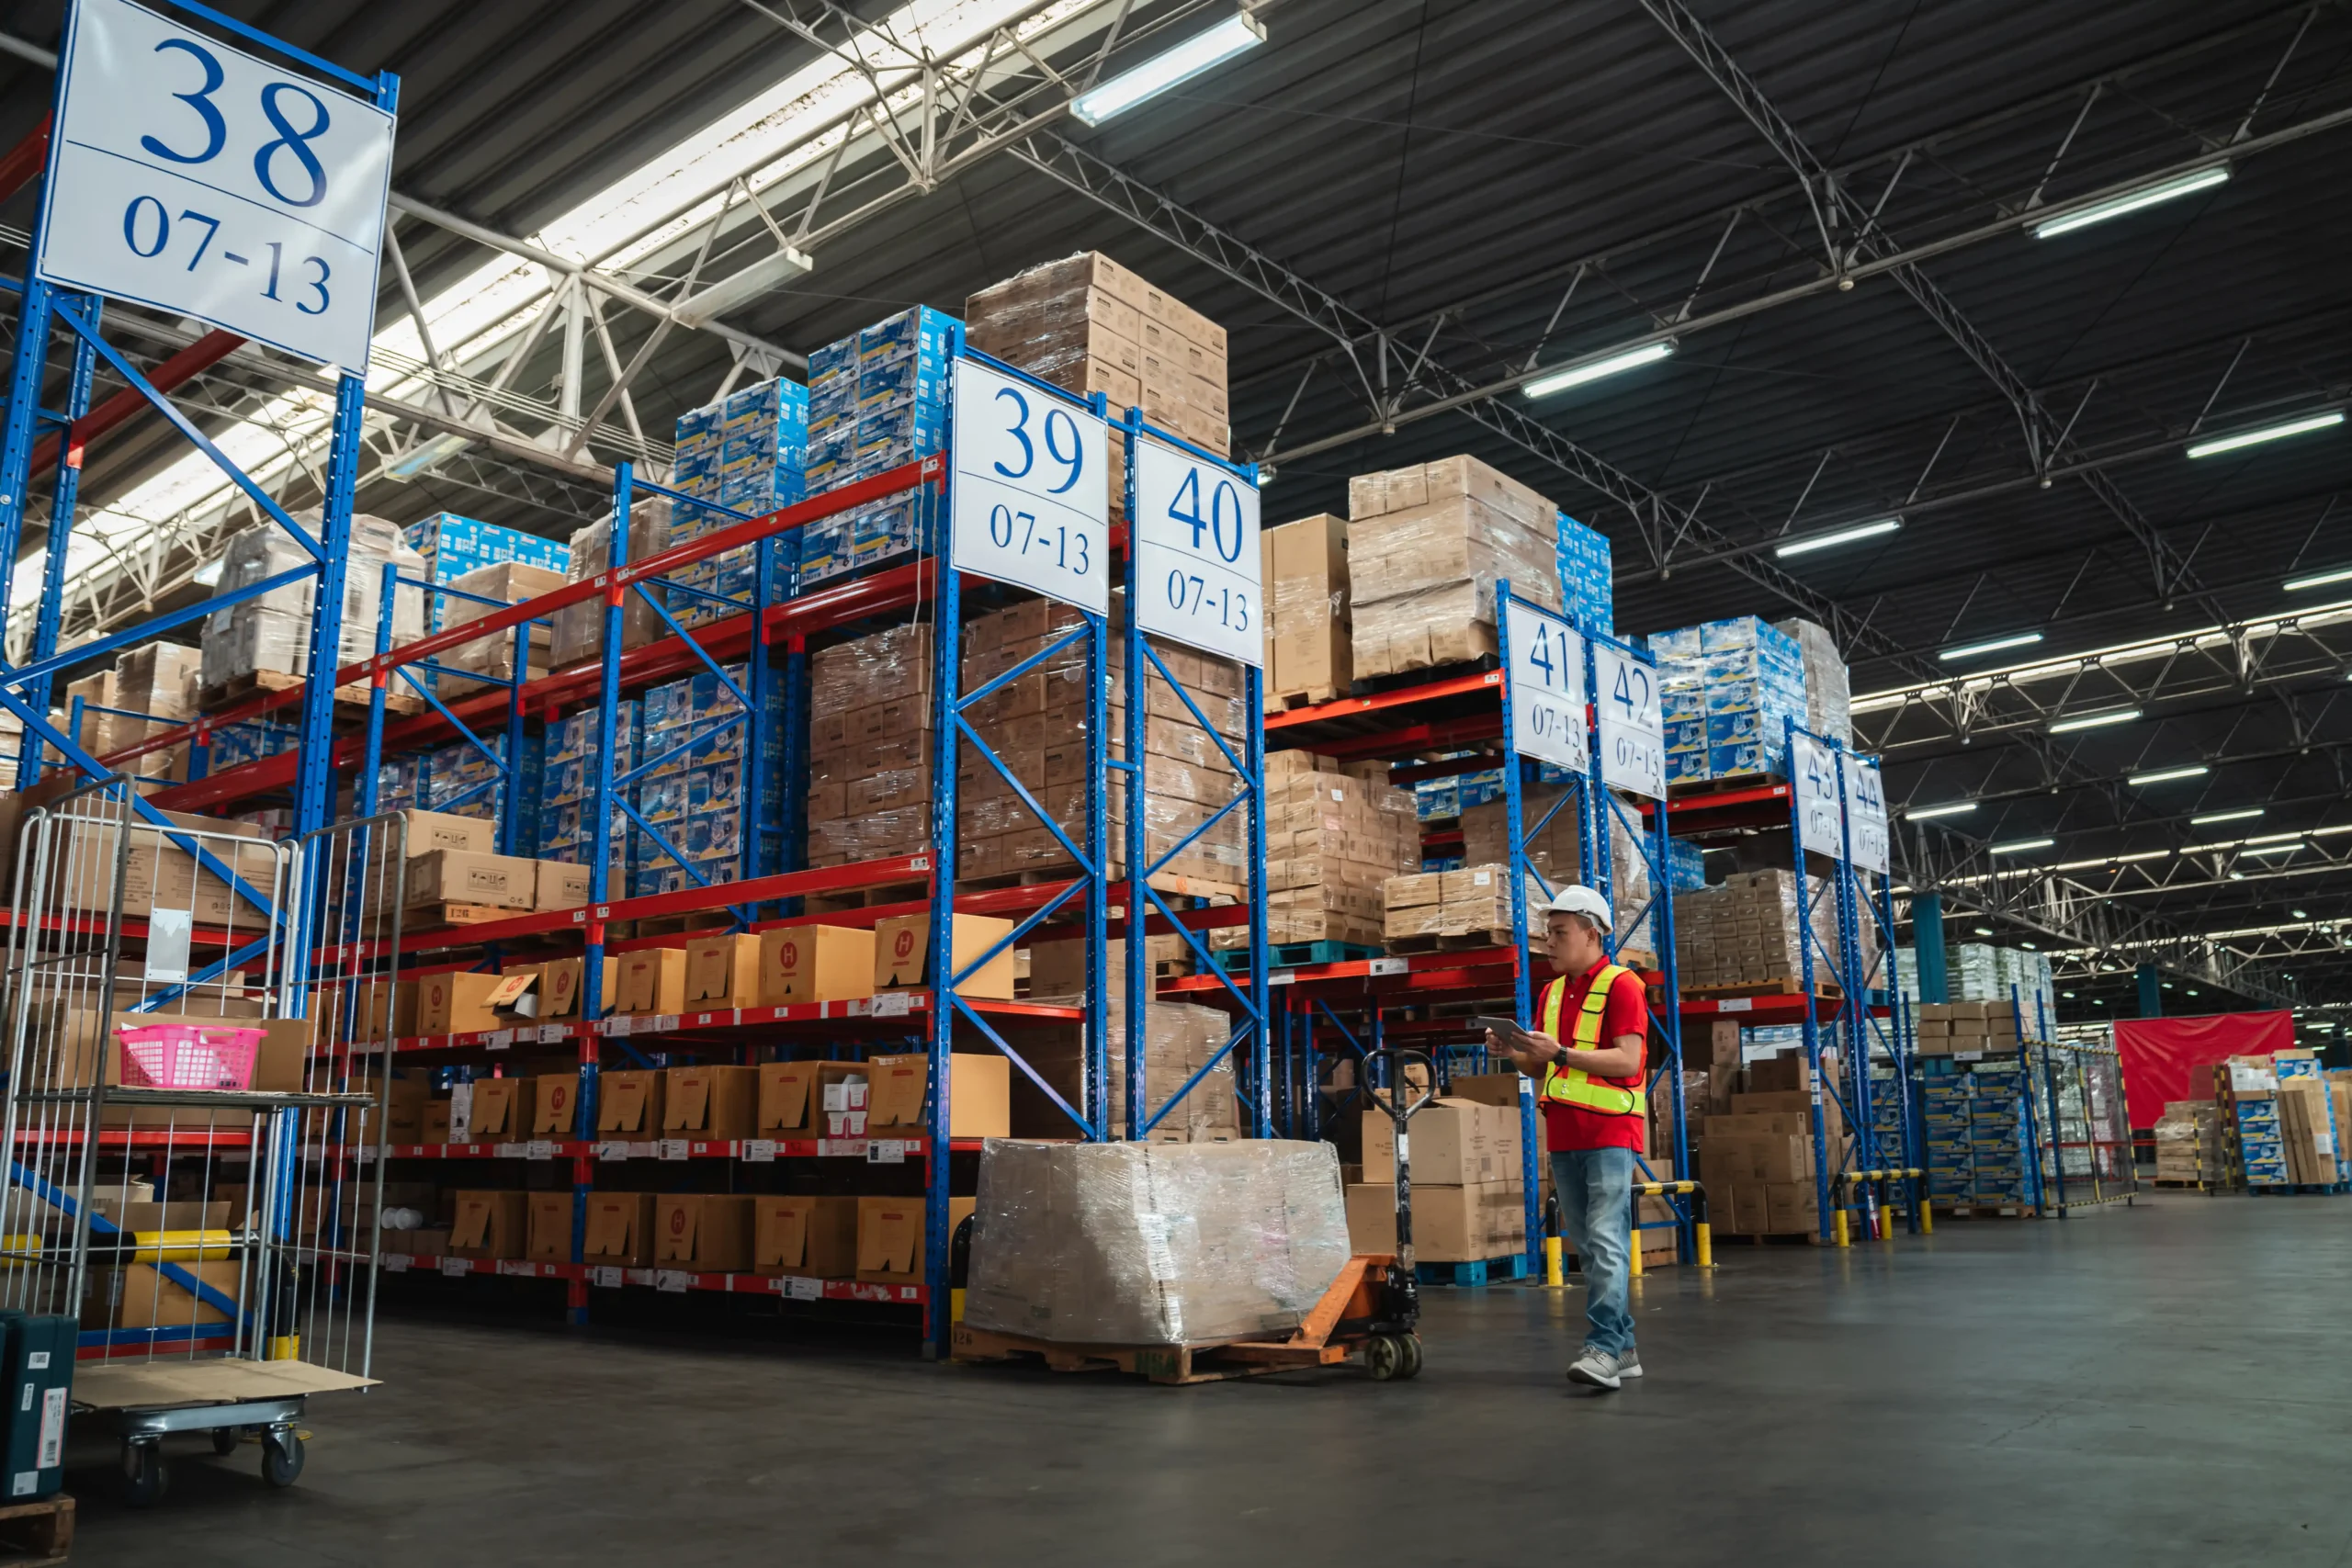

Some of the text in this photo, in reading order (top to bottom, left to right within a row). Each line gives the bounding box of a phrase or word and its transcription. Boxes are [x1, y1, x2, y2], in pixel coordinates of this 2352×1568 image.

[141, 39, 331, 208] 38
[124, 196, 331, 315] 07-13
[994, 387, 1084, 494] 39
[989, 503, 1090, 576] 07-13
[1168, 467, 1243, 563] 40
[1168, 570, 1248, 635] 07-13
[1530, 622, 1569, 694] 41
[1532, 704, 1580, 748] 07-13
[1613, 661, 1654, 728] 42
[1616, 737, 1659, 776] 07-13
[1810, 809, 1838, 840] 07-13
[1856, 769, 1880, 818] 44
